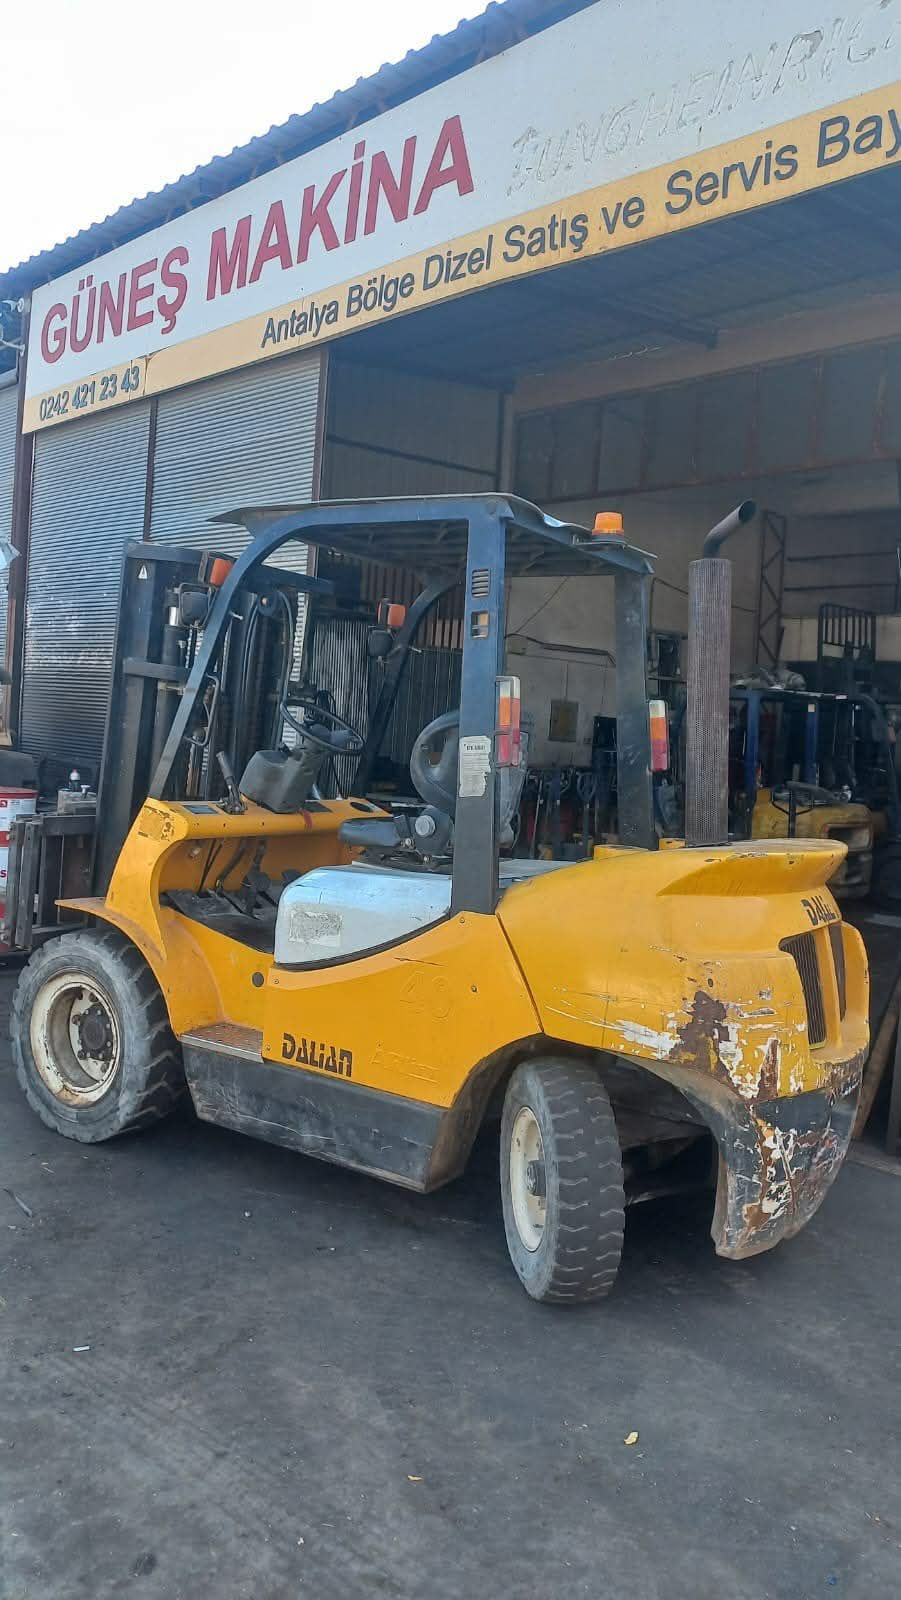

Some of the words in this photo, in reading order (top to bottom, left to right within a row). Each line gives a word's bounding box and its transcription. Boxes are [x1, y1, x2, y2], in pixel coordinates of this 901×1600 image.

[41, 246, 189, 363] GÜNEŞ
[206, 114, 474, 300] MAKİNA
[261, 300, 339, 348] Antalya
[346, 273, 415, 318] Bölge
[423, 234, 493, 290] Dizel
[503, 214, 588, 263] Satış
[601, 197, 645, 235] ve
[665, 141, 798, 214] Servis
[40, 391, 69, 420] 0242
[72, 381, 95, 409] 421
[99, 374, 118, 401] 23
[121, 366, 139, 392] 43
